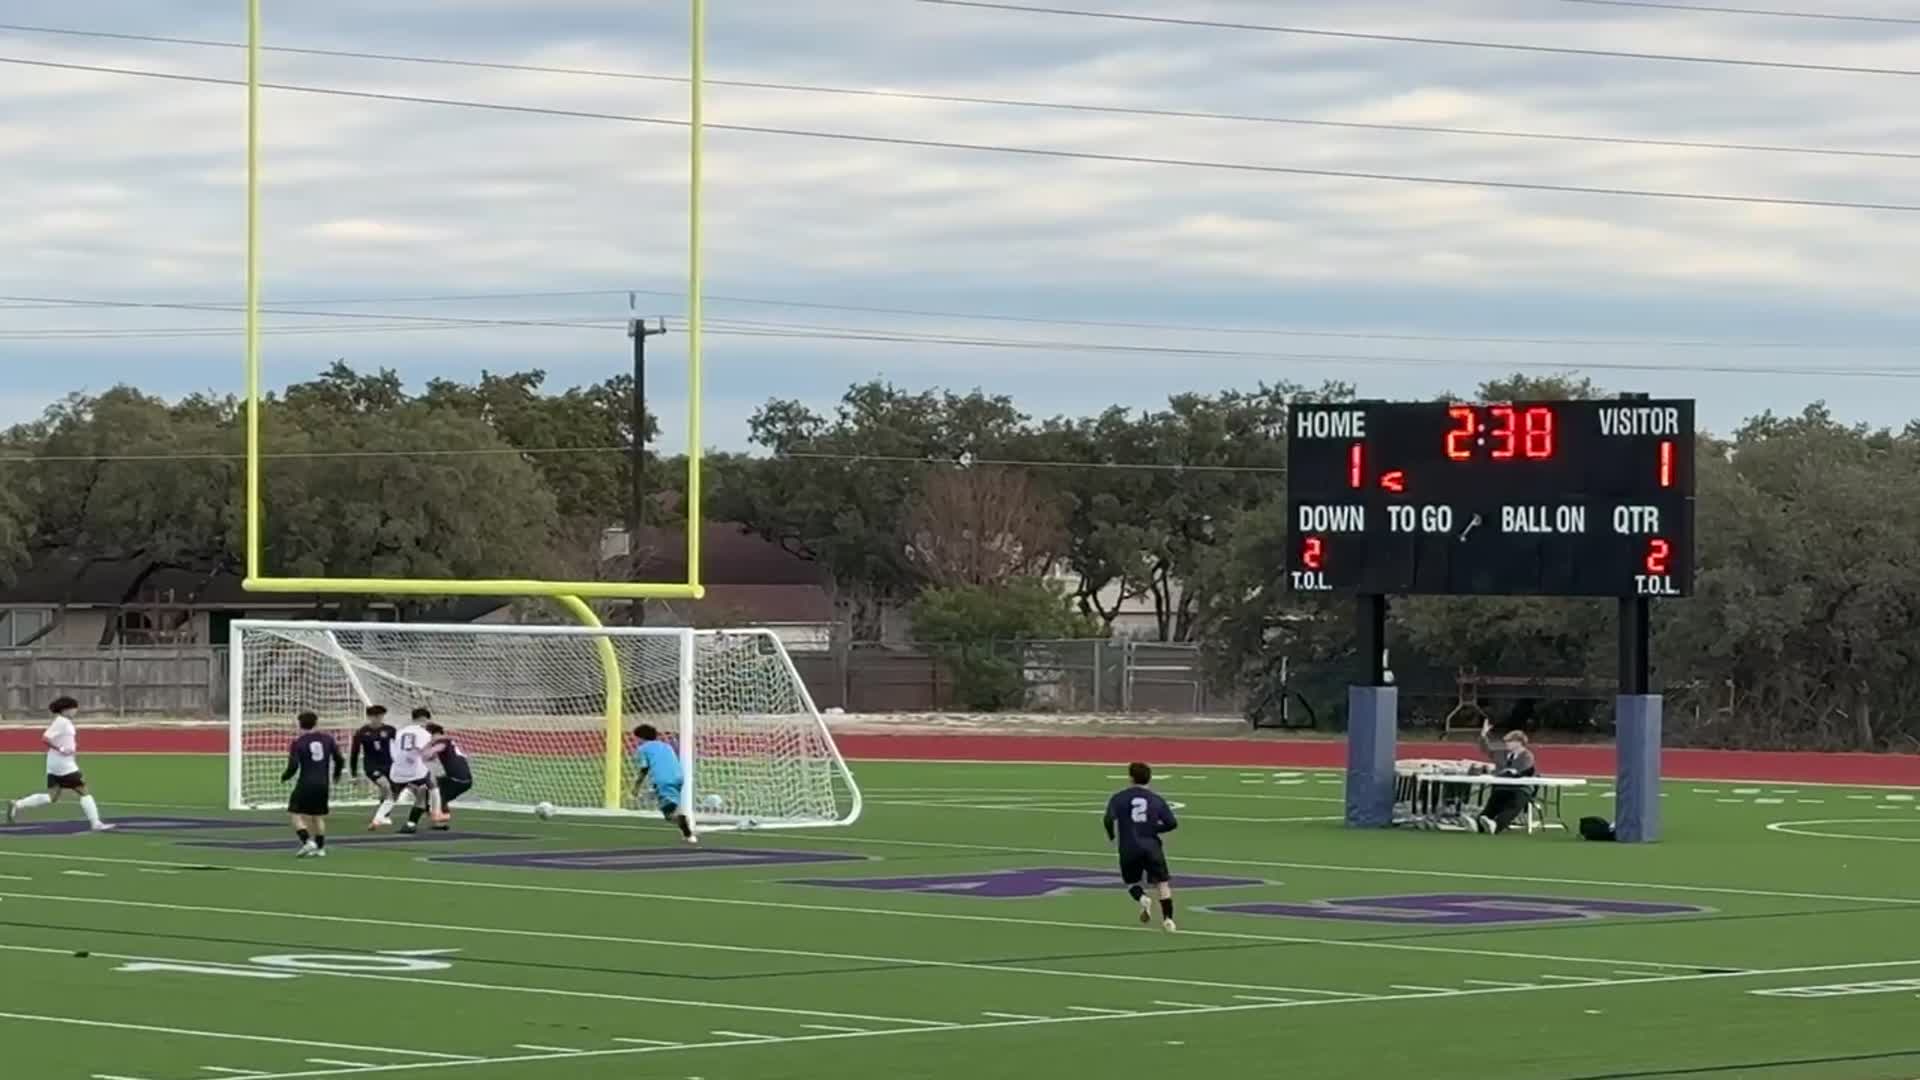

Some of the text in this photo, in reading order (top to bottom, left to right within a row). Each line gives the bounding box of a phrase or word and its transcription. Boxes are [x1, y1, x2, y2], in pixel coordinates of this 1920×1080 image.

[1297, 410, 1366, 438] HOME
[1446, 406, 1553, 459] 2:38
[1599, 407, 1679, 436] VISITOR
[1349, 442, 1363, 488] 1
[1659, 441, 1673, 488] 1
[1299, 505, 1365, 533] DOWN
[1387, 505, 1453, 533] TO GO
[1501, 505, 1585, 534] BALL ON
[1613, 505, 1660, 534] QTR
[1302, 537, 1322, 569] 2
[1646, 540, 1670, 573] 2
[1291, 572, 1333, 591] T.O.L.
[1635, 575, 1680, 595] T.O.L.
[308, 741, 325, 762] 9
[1130, 797, 1148, 823] 2
